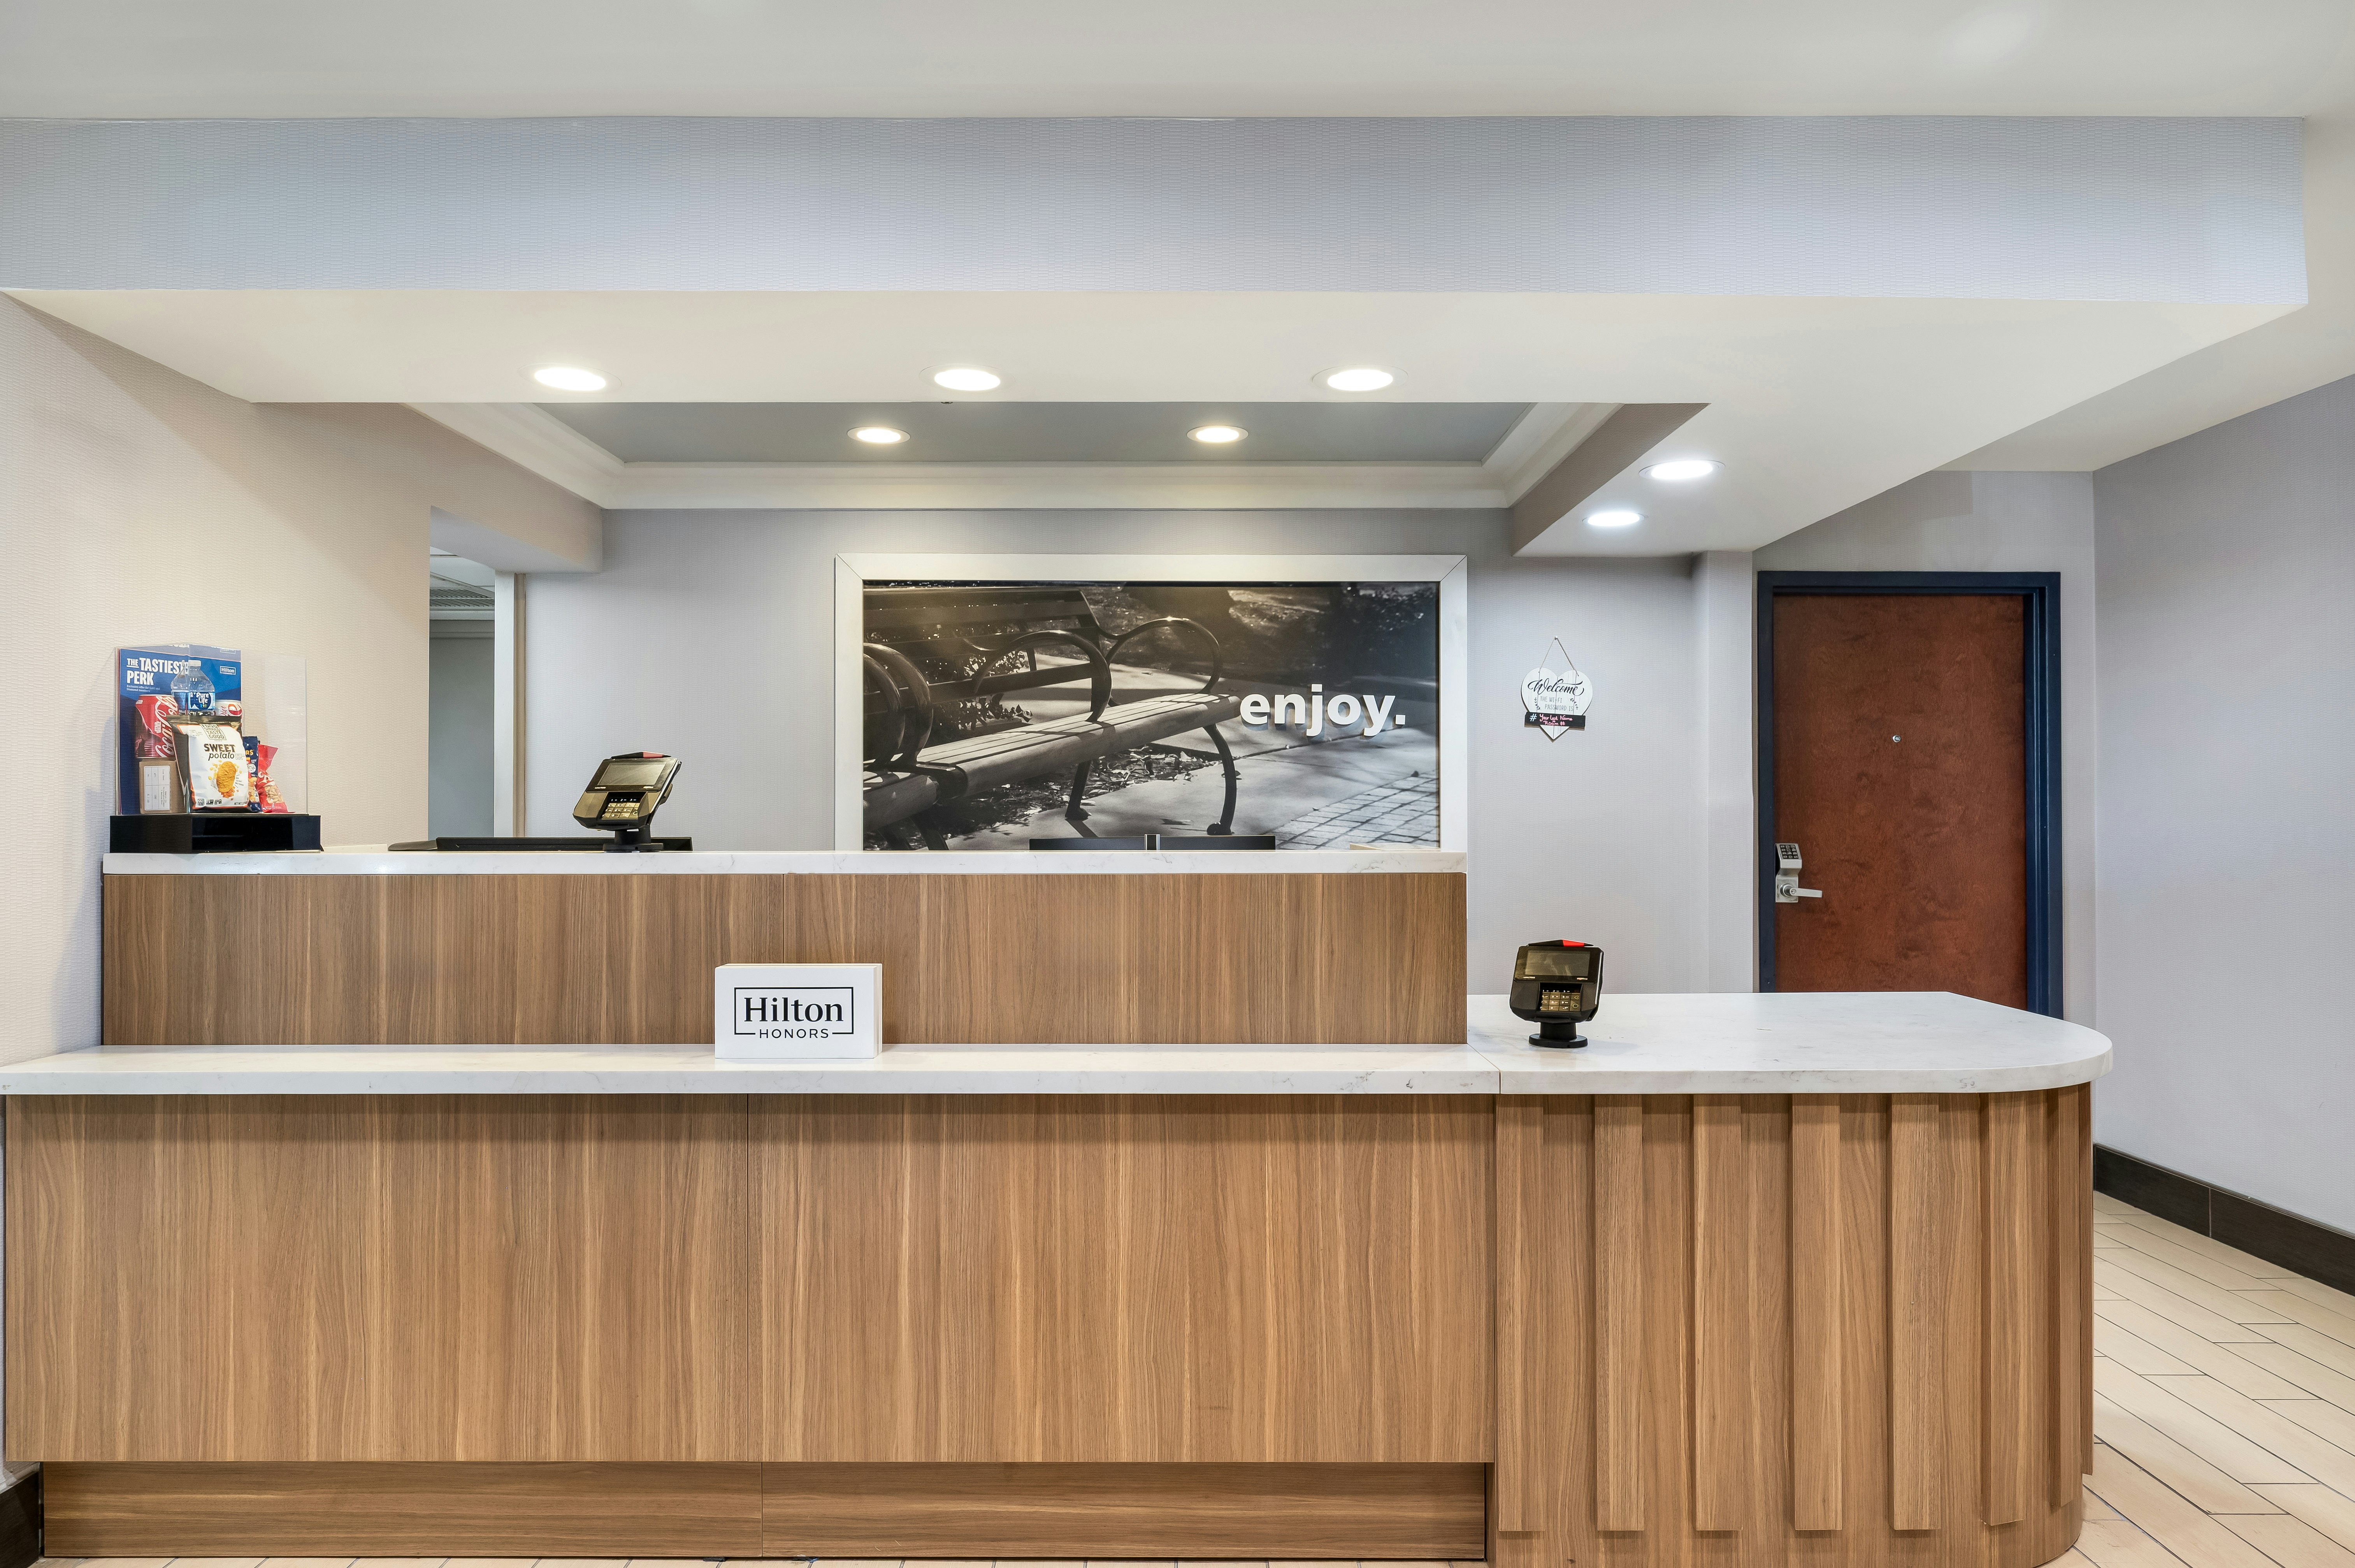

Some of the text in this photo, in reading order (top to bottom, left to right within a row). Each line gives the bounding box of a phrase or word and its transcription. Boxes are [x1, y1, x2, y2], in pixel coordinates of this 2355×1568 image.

[126, 658, 139, 666] THE
[126, 670, 154, 686] PERK
[1528, 678, 1584, 696] Welcome
[1240, 684, 1405, 737] enjoy.
[204, 744, 236, 752] SWEET
[208, 751, 234, 761] potato
[744, 997, 844, 1022] Hilton
[759, 1028, 829, 1038] HONORS
